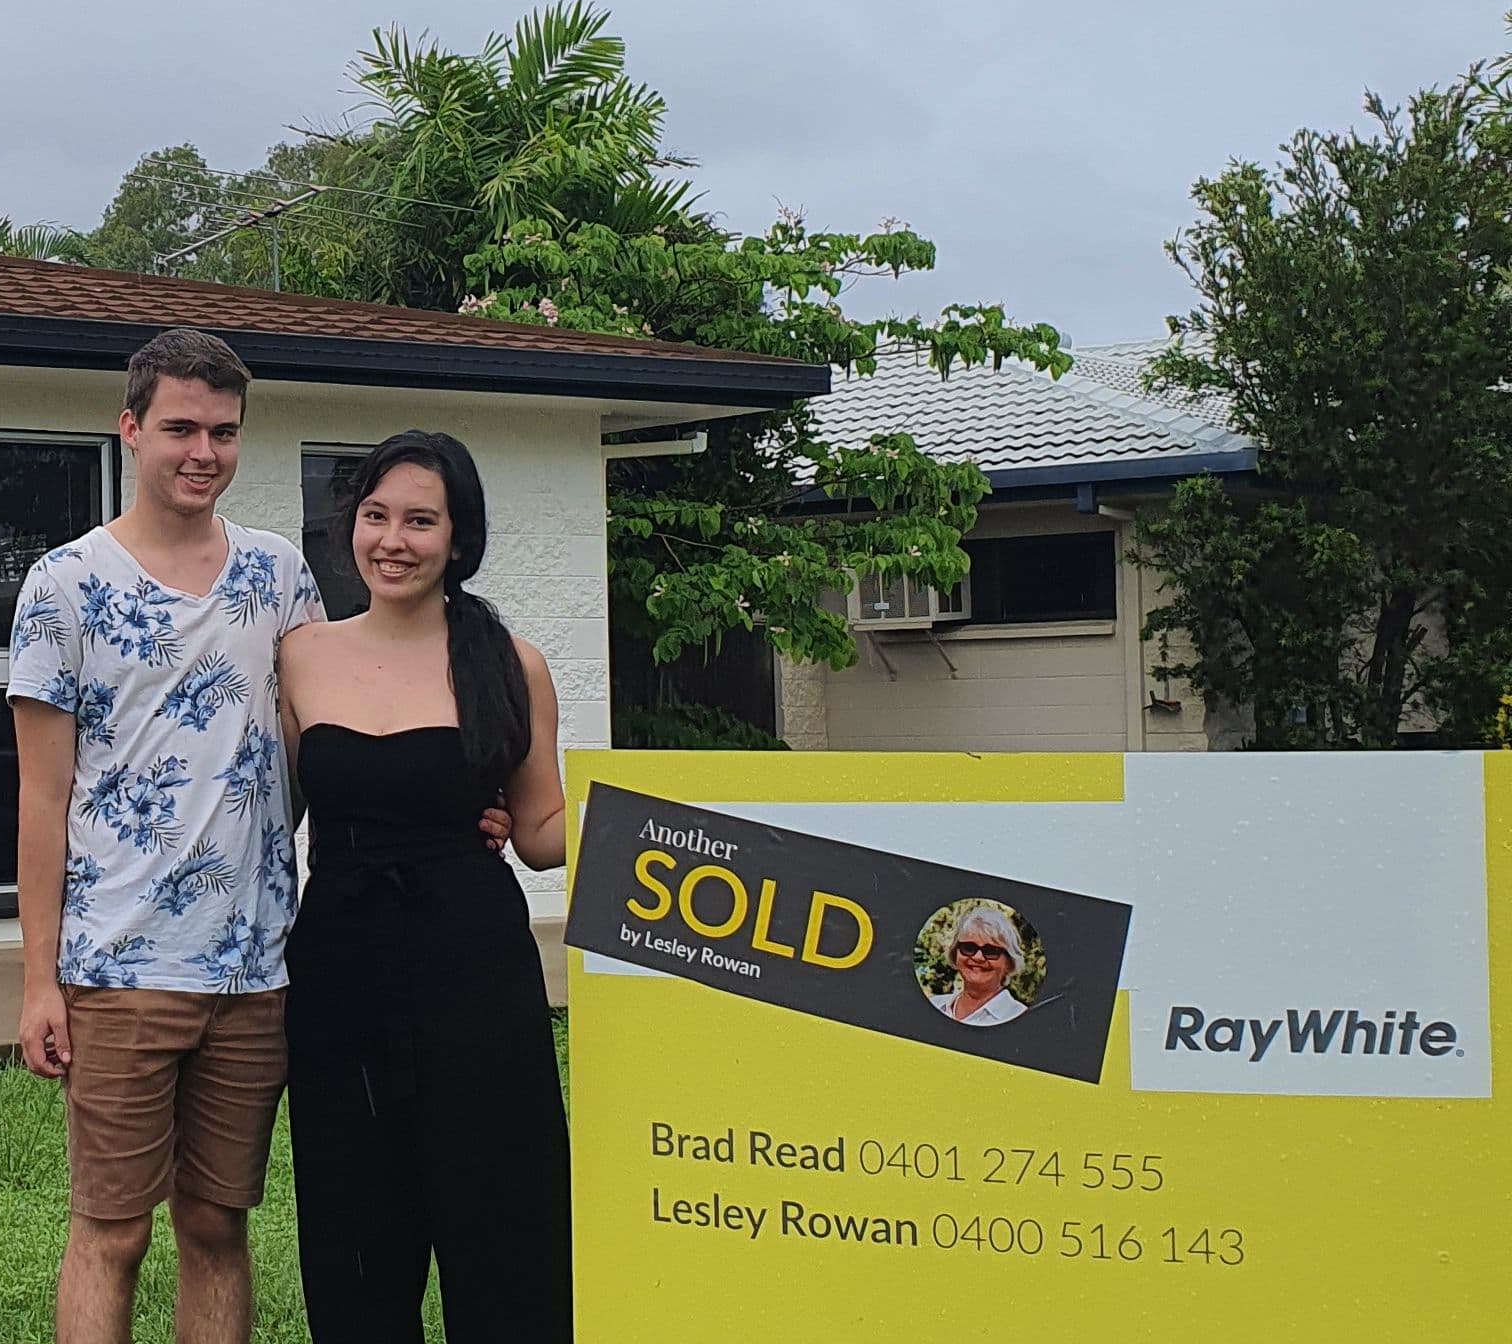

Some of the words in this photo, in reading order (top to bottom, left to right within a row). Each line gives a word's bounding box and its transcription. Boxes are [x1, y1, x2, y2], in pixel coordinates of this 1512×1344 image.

[639, 818, 739, 862] Another
[626, 849, 875, 970] SOLD
[619, 923, 643, 948] by
[644, 928, 698, 963] Lesley
[700, 946, 762, 979] Rowan
[651, 1122, 735, 1164] Brad
[748, 1131, 846, 1173] Read
[859, 1139, 967, 1182] 0401
[981, 1147, 1066, 1188] 274
[1080, 1152, 1165, 1192] 555
[652, 1188, 768, 1239] Lesley
[781, 1200, 919, 1246] Rowan
[932, 1213, 1044, 1256] 0400
[1059, 1221, 1144, 1261] 516
[1161, 1226, 1245, 1266] 143
